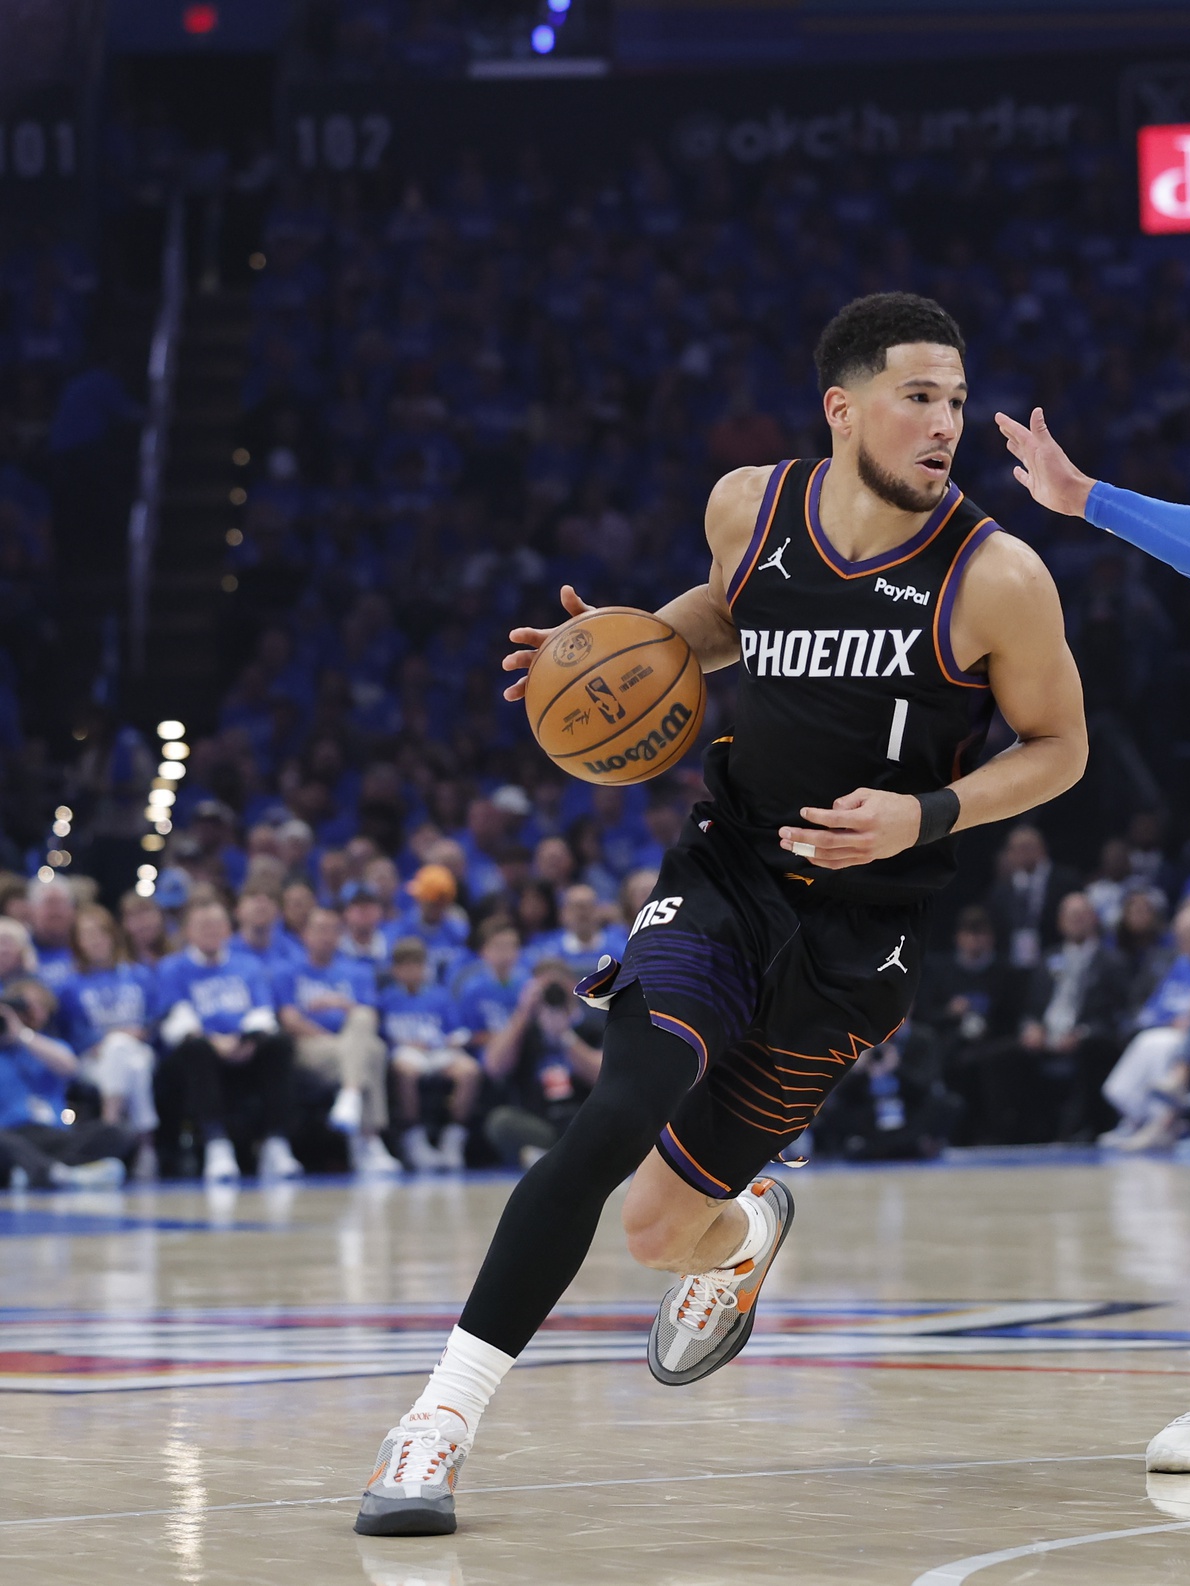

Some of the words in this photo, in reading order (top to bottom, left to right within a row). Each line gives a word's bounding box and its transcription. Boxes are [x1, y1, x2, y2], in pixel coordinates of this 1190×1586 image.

[874, 577, 931, 606] PayPal
[740, 629, 922, 677] PHOENIX
[583, 702, 693, 775] Wilson
[886, 698, 909, 762] 1
[627, 896, 684, 942] NS
